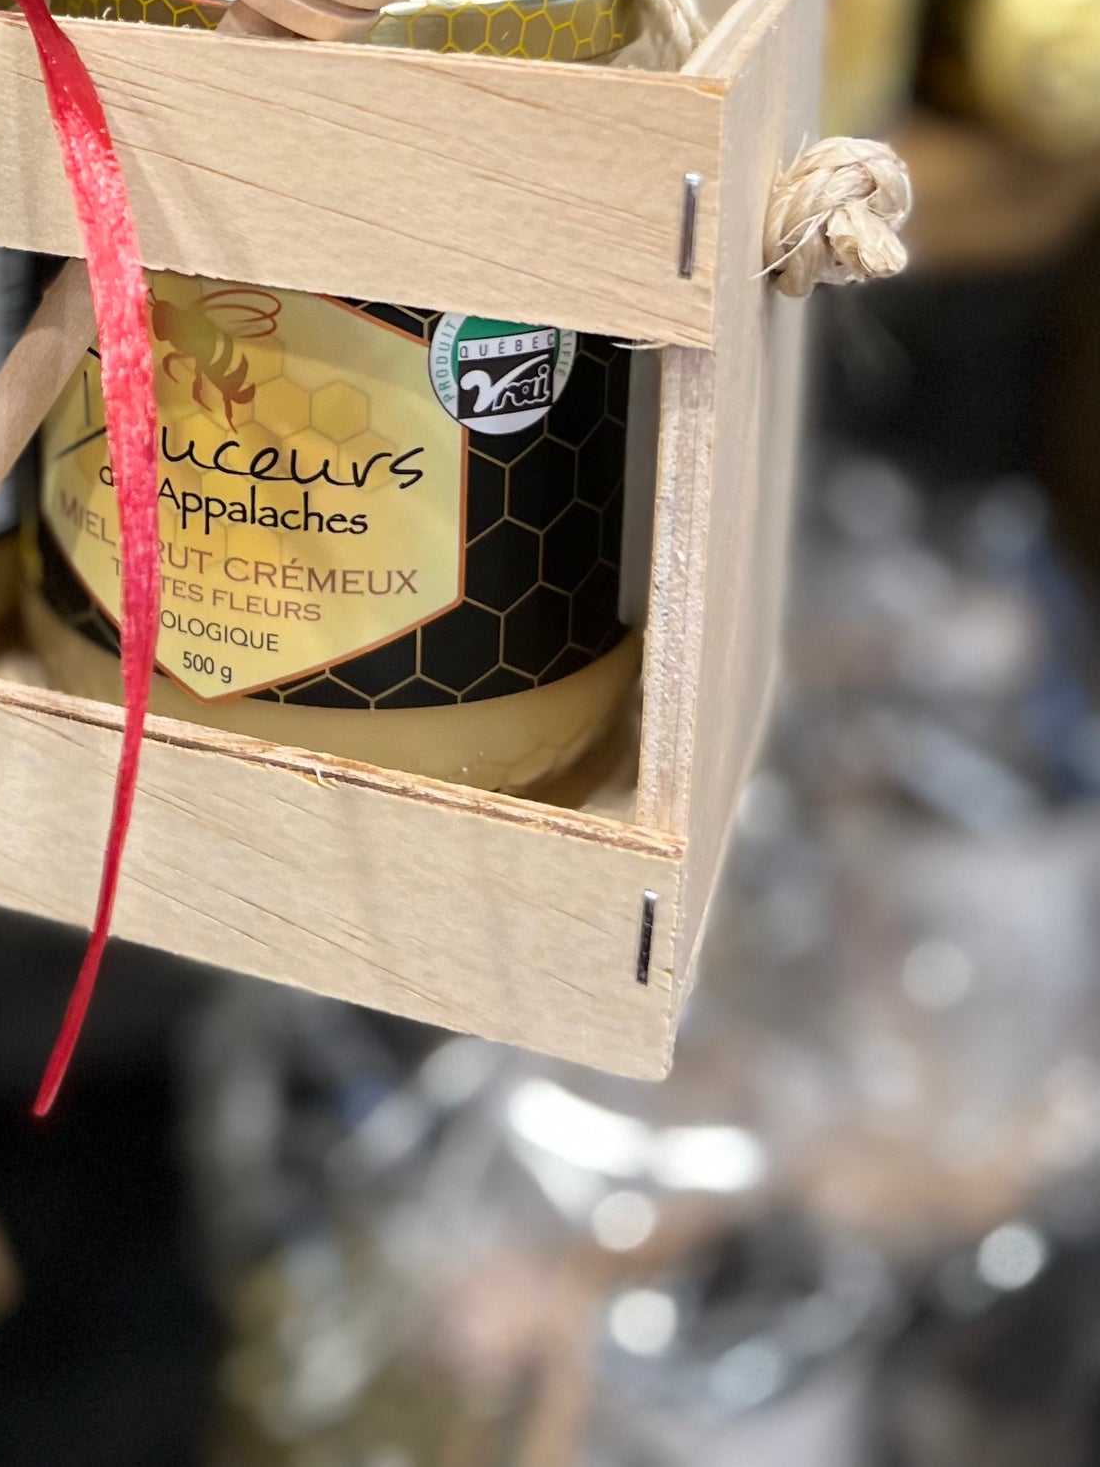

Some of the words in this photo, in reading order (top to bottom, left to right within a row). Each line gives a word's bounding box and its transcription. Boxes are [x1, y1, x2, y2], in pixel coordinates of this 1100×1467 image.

[435, 321, 458, 403] PRODUIT
[459, 333, 555, 359] QUÉBEC
[460, 354, 550, 413] Vrai
[158, 477, 368, 535] Appalaches
[60, 490, 117, 546] MIEL
[158, 540, 213, 574] RUT
[224, 557, 419, 596] CRÉMEUX
[212, 588, 322, 622] FLEURS
[160, 610, 279, 652] OLOGIQUE
[182, 651, 215, 674] 500
[220, 665, 233, 684] g
